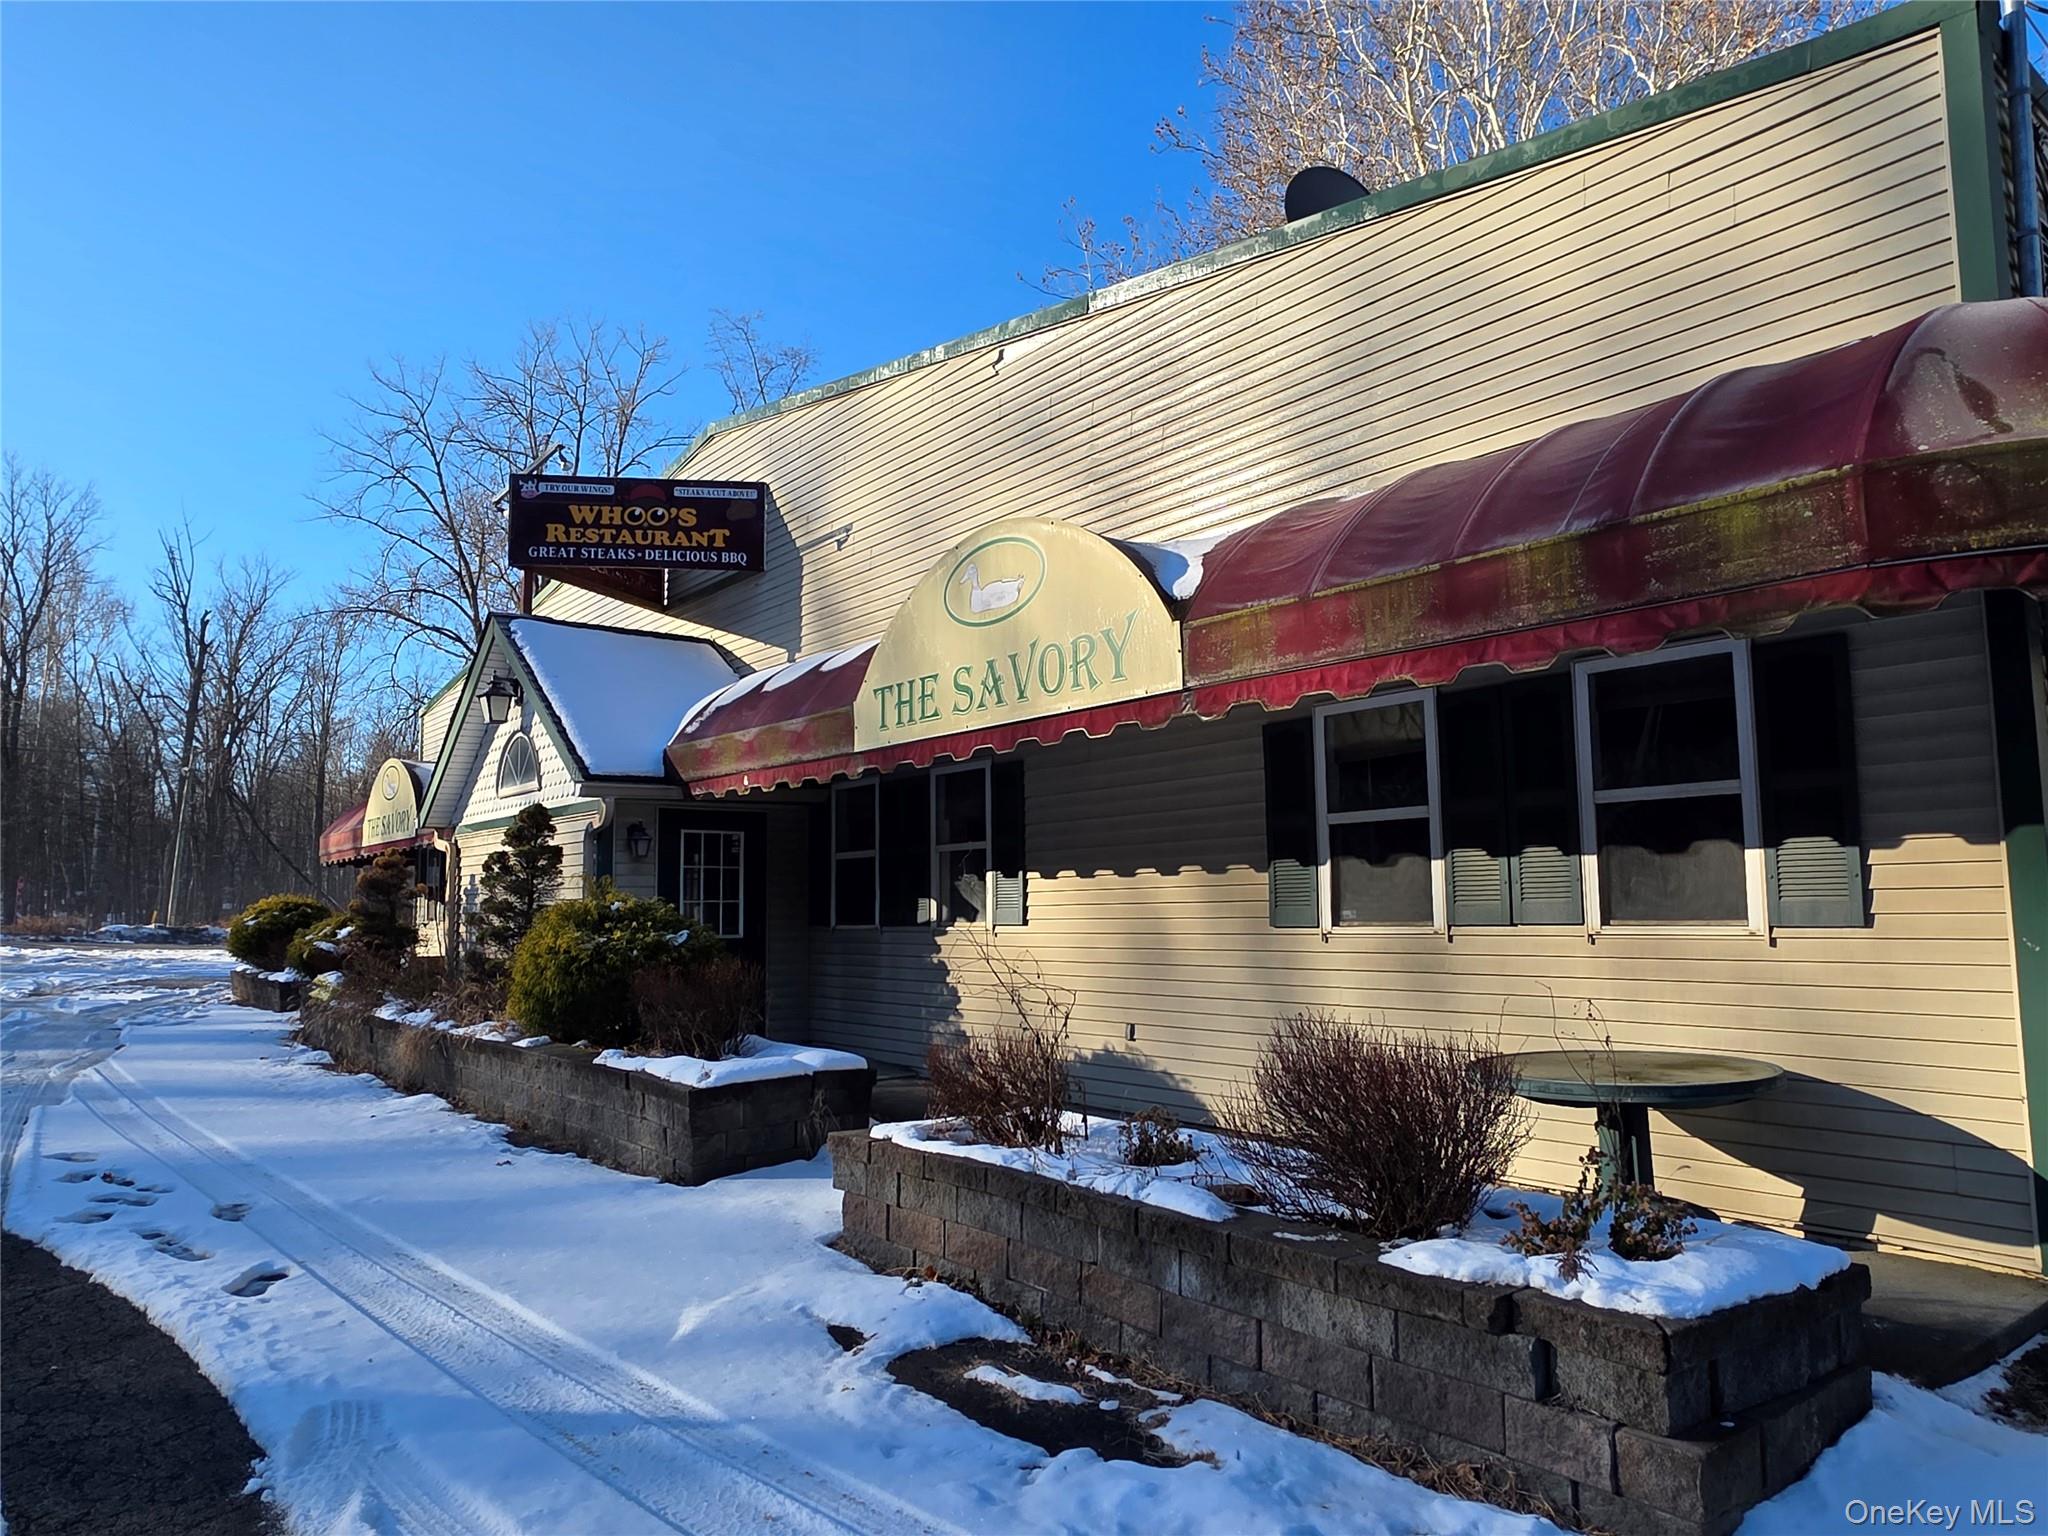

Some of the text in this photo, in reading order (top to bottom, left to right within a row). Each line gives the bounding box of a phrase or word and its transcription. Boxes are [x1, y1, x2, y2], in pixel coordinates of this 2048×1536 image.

[562, 484, 579, 492] OUR
[568, 504, 697, 527] WHOO'S
[545, 523, 730, 547] RESTAURANT
[528, 546, 748, 565] GREAT STEAKS DELICIOUS BBQ
[873, 608, 1139, 732] THE SAVORY
[368, 804, 413, 841] THE SAVORY
